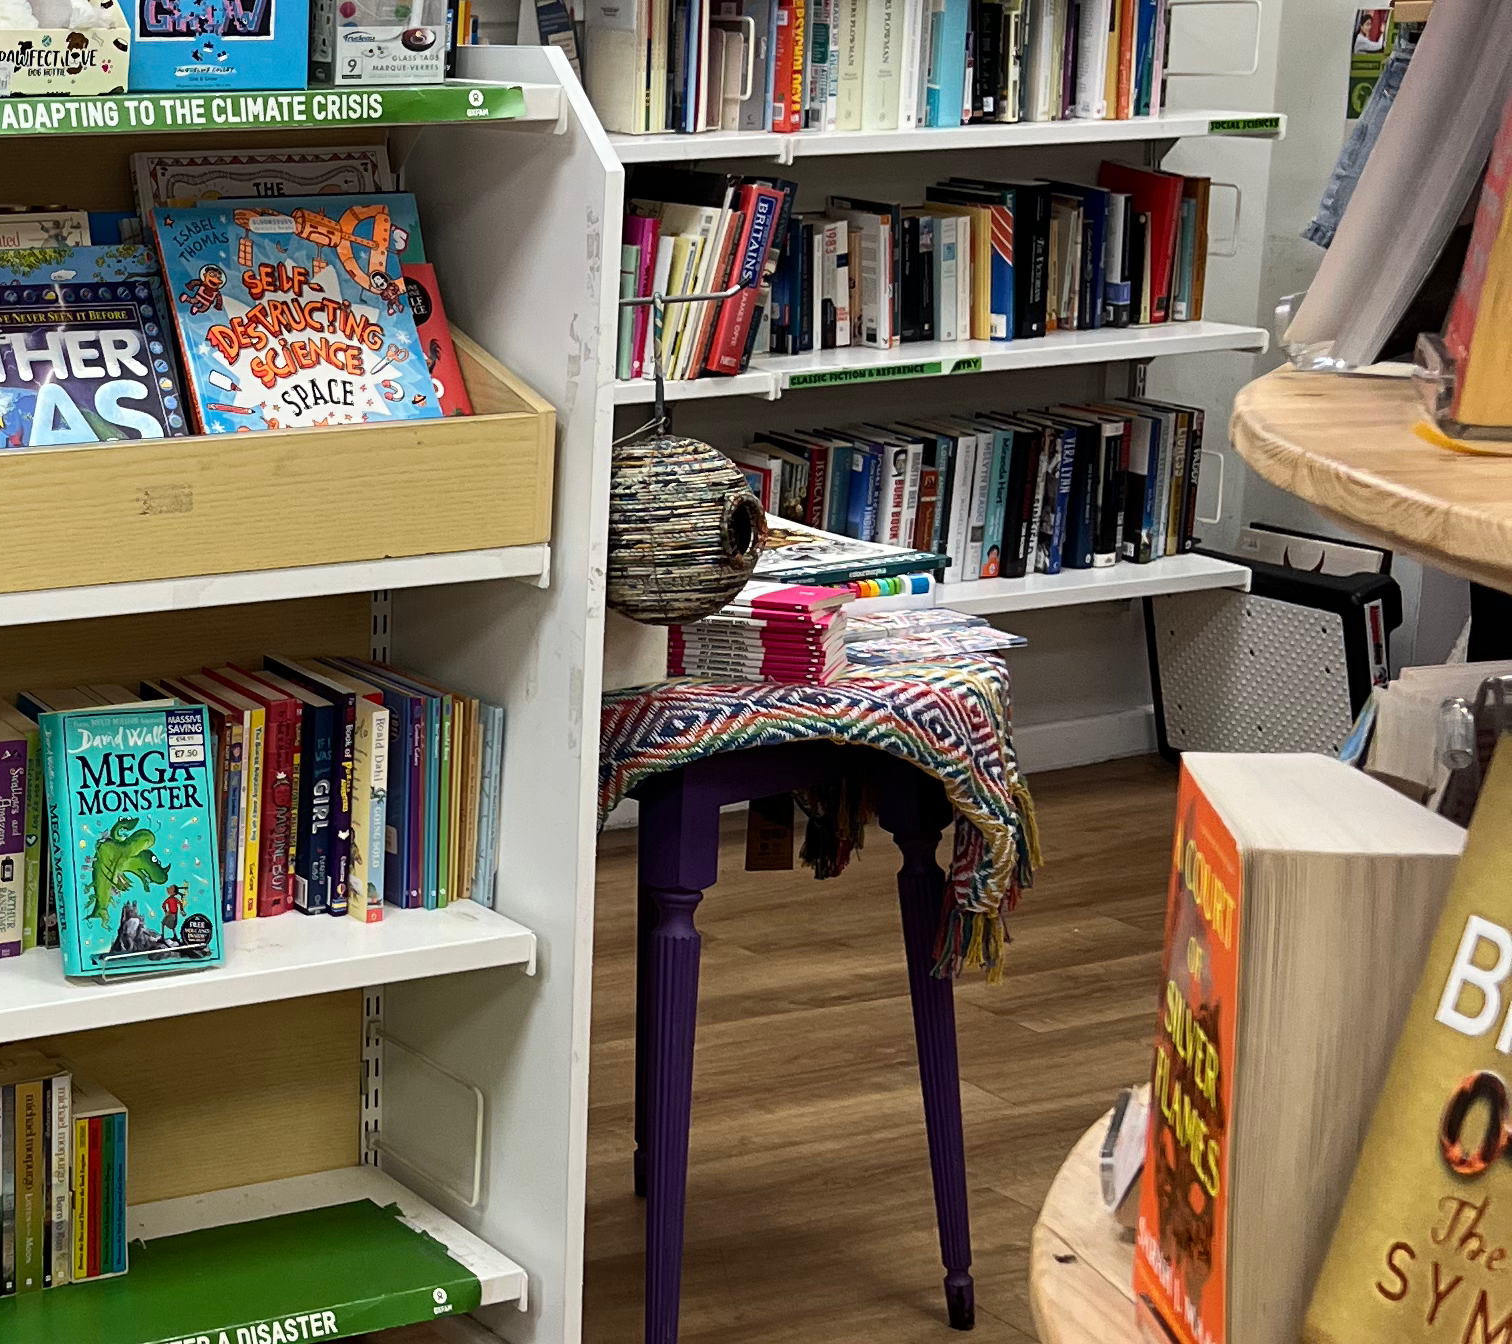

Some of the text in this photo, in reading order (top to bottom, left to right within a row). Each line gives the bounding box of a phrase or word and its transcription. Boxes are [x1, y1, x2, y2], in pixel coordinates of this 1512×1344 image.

[1, 99, 119, 129] ADAPTING
[125, 99, 155, 126] TO
[161, 97, 206, 124] THE
[212, 95, 305, 123] CLIMATE
[313, 93, 383, 121] CRISIS
[281, 378, 354, 417] SPACE
[168, 715, 202, 725] MASSIVE
[168, 724, 203, 734] SAVING
[76, 750, 196, 789] MEGA
[174, 749, 198, 759] £7.50
[78, 784, 204, 816] MONSTER
[312, 779, 330, 835] GIRL
[1186, 840, 1237, 950] COURT
[1164, 980, 1219, 1108] SILVER
[1155, 1047, 1219, 1197] FLAMES
